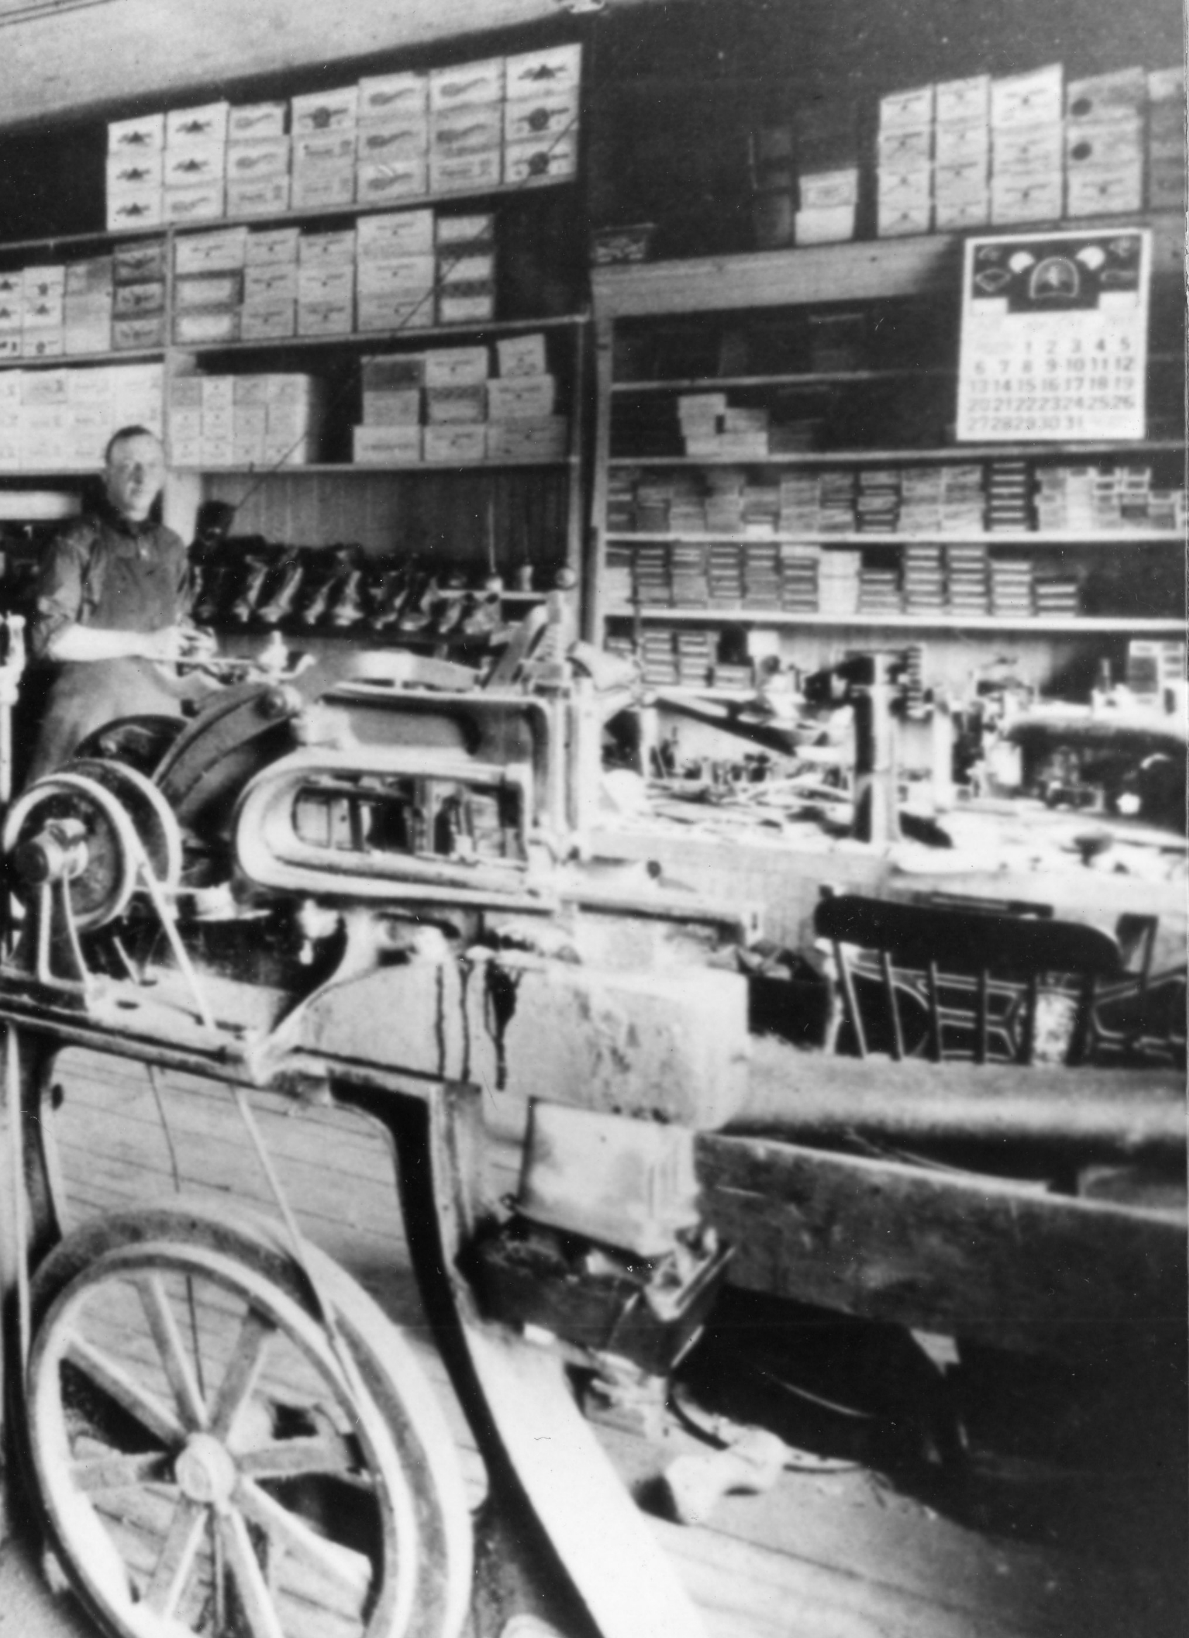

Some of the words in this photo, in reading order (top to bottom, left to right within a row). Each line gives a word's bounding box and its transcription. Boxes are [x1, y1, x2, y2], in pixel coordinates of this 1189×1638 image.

[1025, 340, 1032, 354] 1
[1046, 340, 1057, 355] 2
[1071, 338, 1082, 353] 3
[1094, 337, 1106, 352] 4
[1120, 336, 1130, 351] 5
[974, 361, 986, 374] 6
[999, 360, 1010, 373] 7
[1022, 360, 1032, 373] 8
[1047, 358, 1057, 373] 9
[1066, 358, 1085, 372] 10
[1091, 357, 1109, 371] 11
[1115, 356, 1135, 372] 12
[994, 380, 1012, 392] 14
[1018, 379, 1036, 392] 15
[1042, 378, 1059, 391] 16
[1065, 376, 1084, 391] 17
[1090, 376, 1109, 390] 18
[1114, 376, 1134, 390] 19
[993, 398, 1012, 412] 21
[1015, 397, 1037, 412] 22
[1039, 397, 1061, 411] 23
[1063, 396, 1084, 410] 24
[1087, 396, 1110, 410] 25
[1112, 395, 1135, 409] 26
[967, 416, 989, 431] 27
[991, 415, 1013, 431] 28
[1014, 415, 1036, 431] 29
